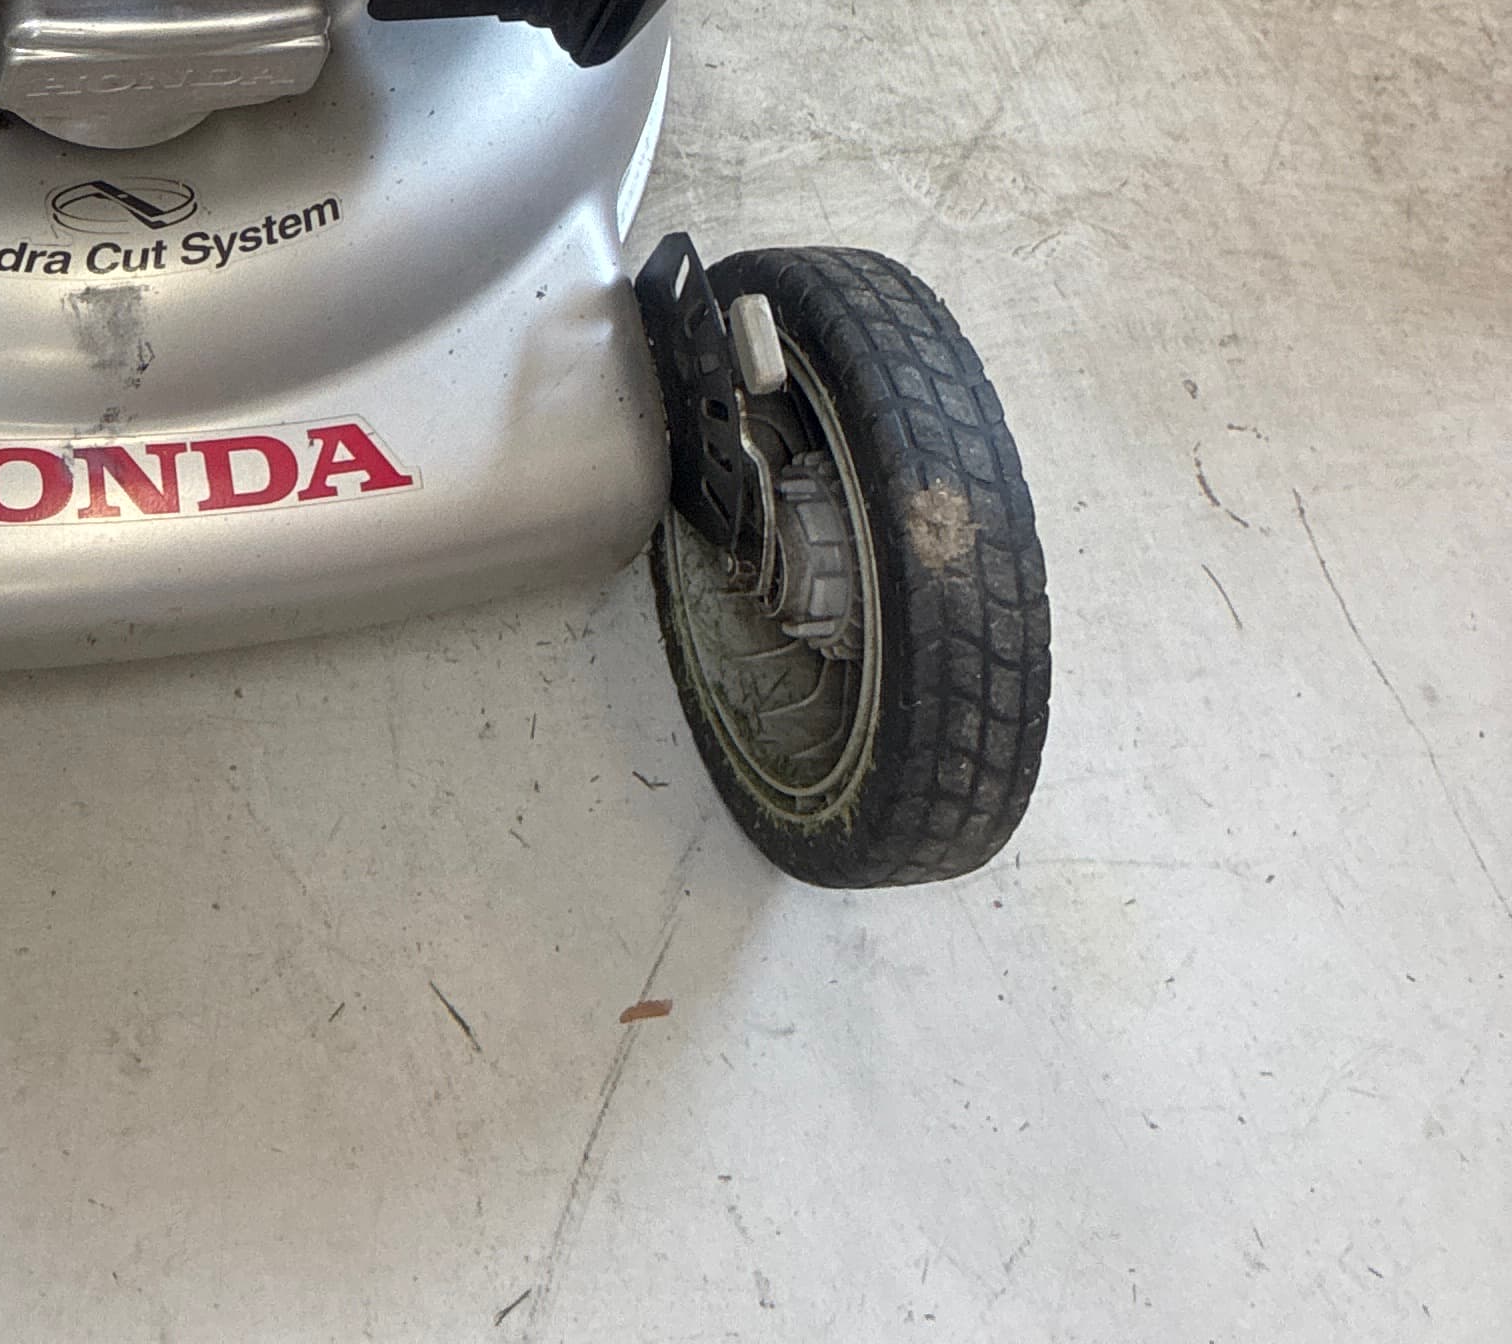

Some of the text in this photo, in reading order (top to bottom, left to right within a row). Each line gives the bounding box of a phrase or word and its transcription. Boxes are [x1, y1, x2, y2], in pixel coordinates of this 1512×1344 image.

[26, 64, 296, 98] HONDA
[86, 239, 166, 275] Cut
[180, 195, 341, 269] System
